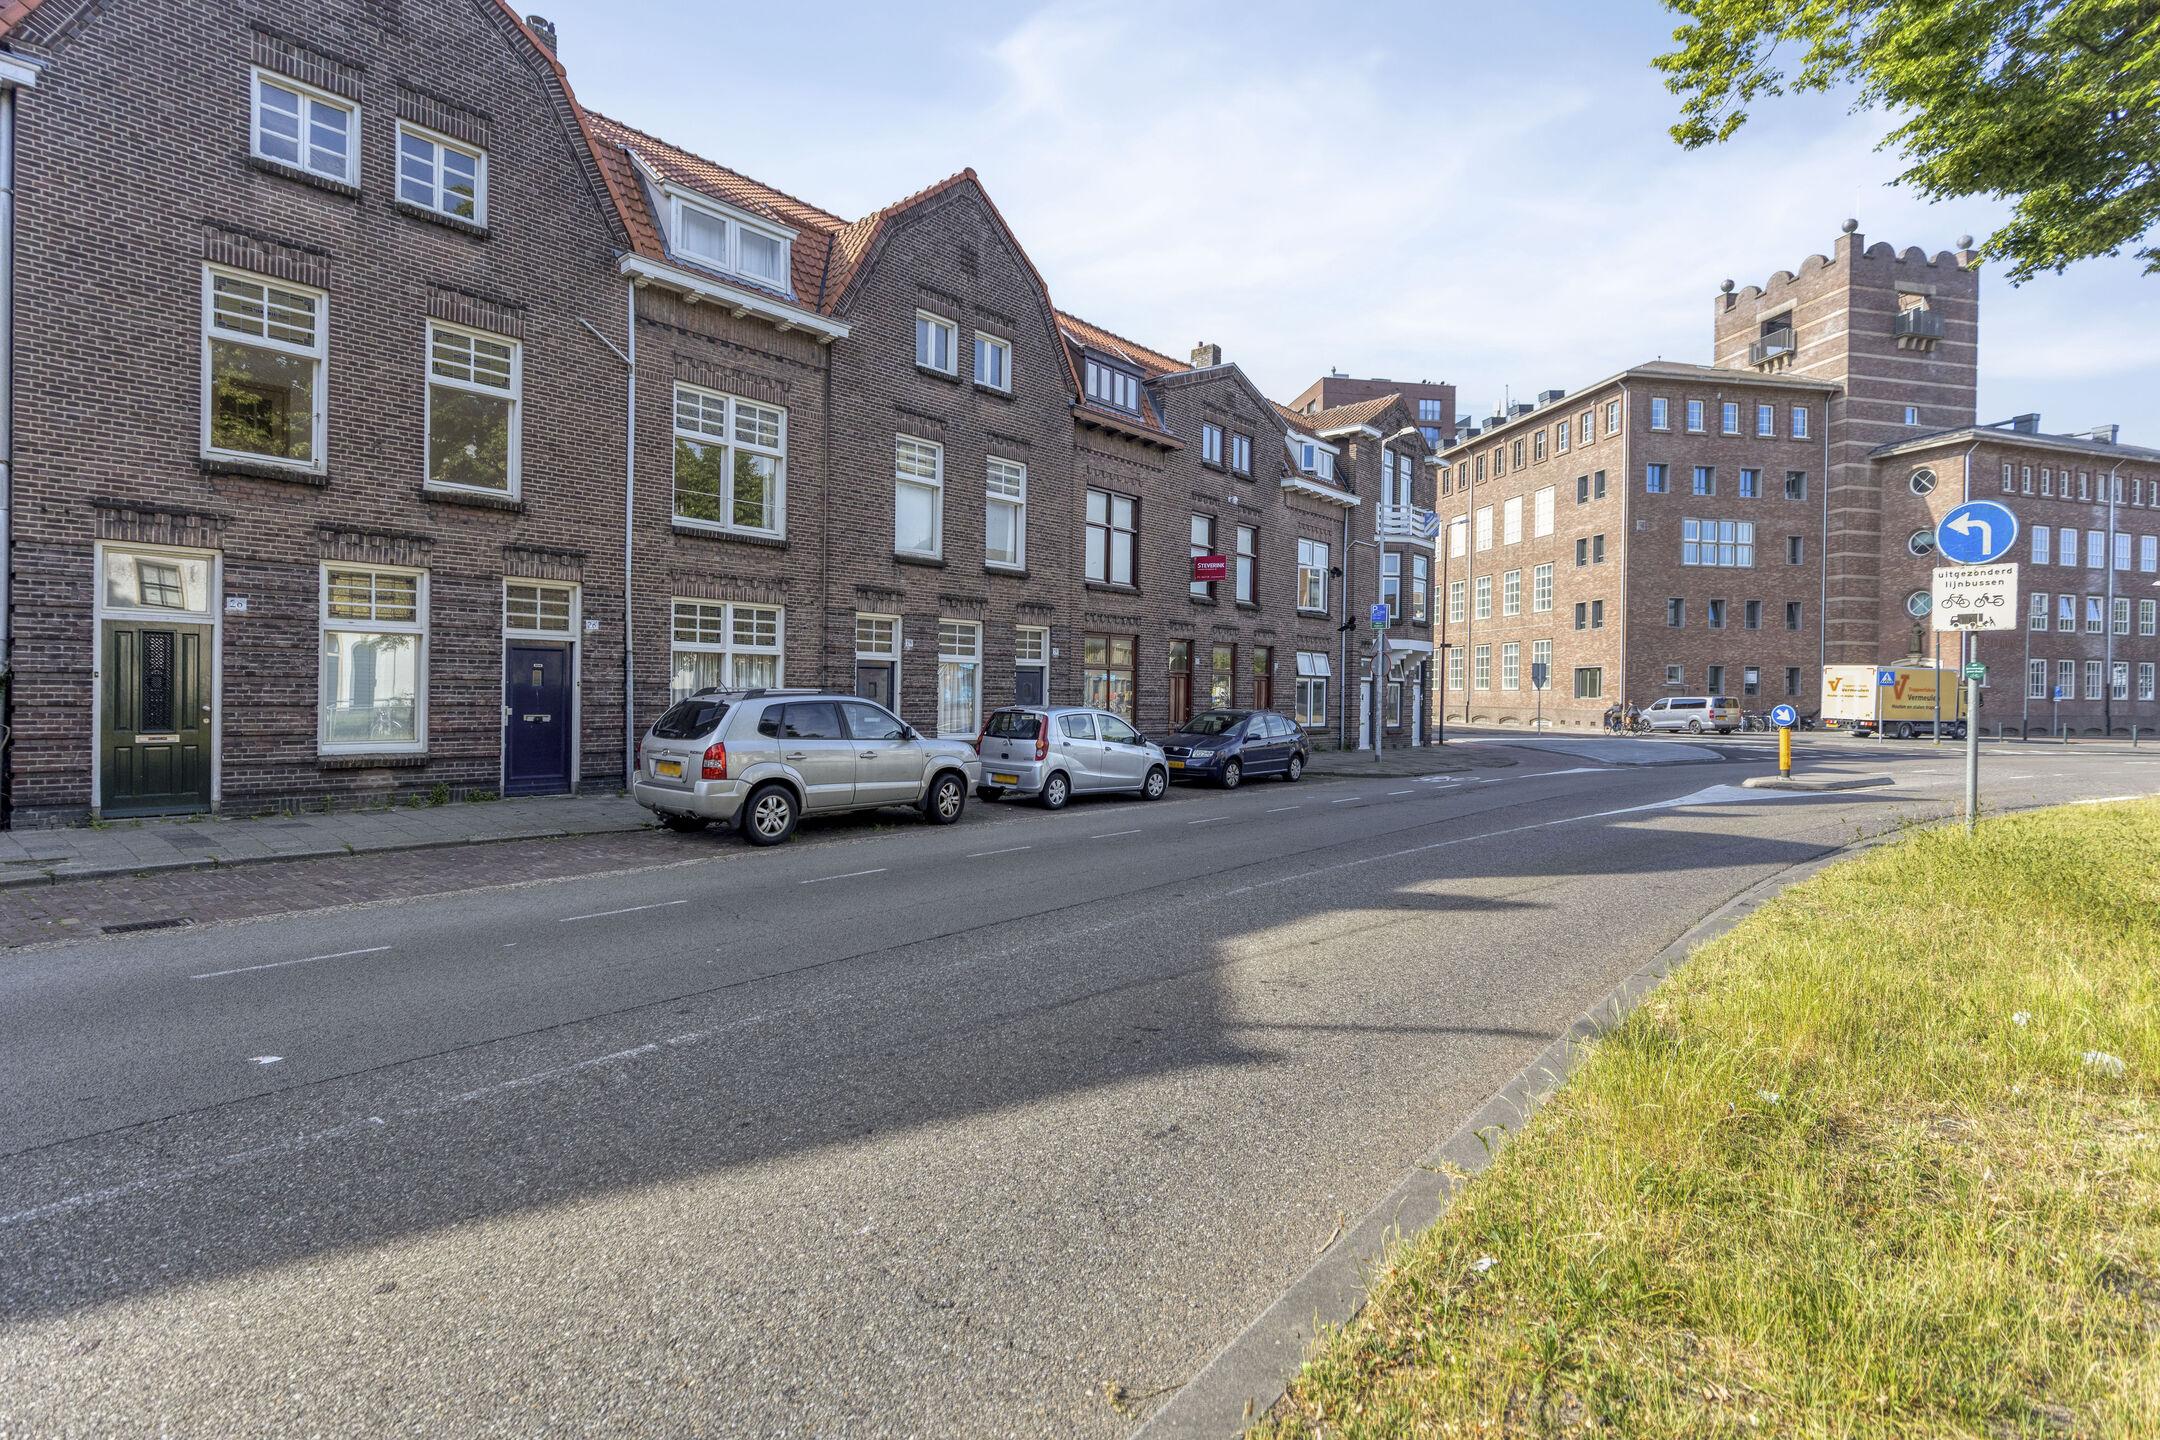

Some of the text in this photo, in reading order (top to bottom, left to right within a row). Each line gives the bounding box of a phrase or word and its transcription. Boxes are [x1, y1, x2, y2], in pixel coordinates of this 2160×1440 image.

[1938, 567, 2013, 580] uitgezonderd
[1945, 579, 2004, 589] lijnbussen
[1907, 694, 1939, 702] Vermeule
